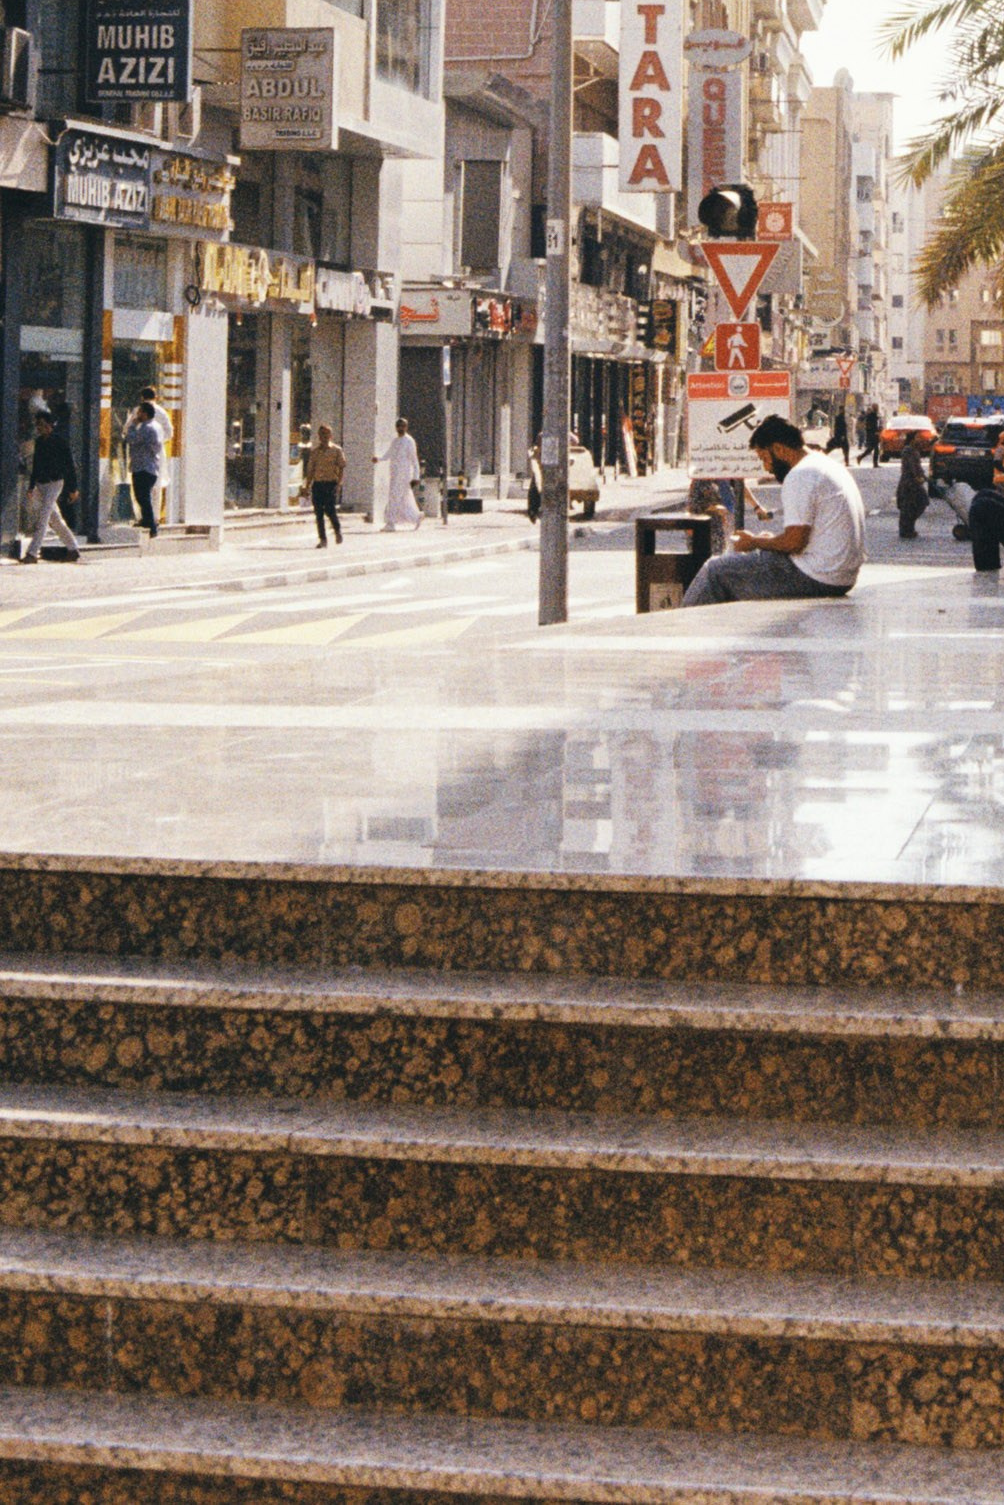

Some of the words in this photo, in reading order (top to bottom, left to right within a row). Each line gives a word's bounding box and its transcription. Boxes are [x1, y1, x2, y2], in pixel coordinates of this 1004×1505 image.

[97, 24, 175, 49] MUHIB
[96, 56, 175, 84] AZIZI
[247, 78, 324, 98] ABDUL
[243, 105, 282, 122] BASIR
[284, 105, 321, 122] RAFIQ
[112, 147, 150, 175] محب
[68, 173, 111, 208] MUHIB
[113, 179, 149, 214] AZIZI
